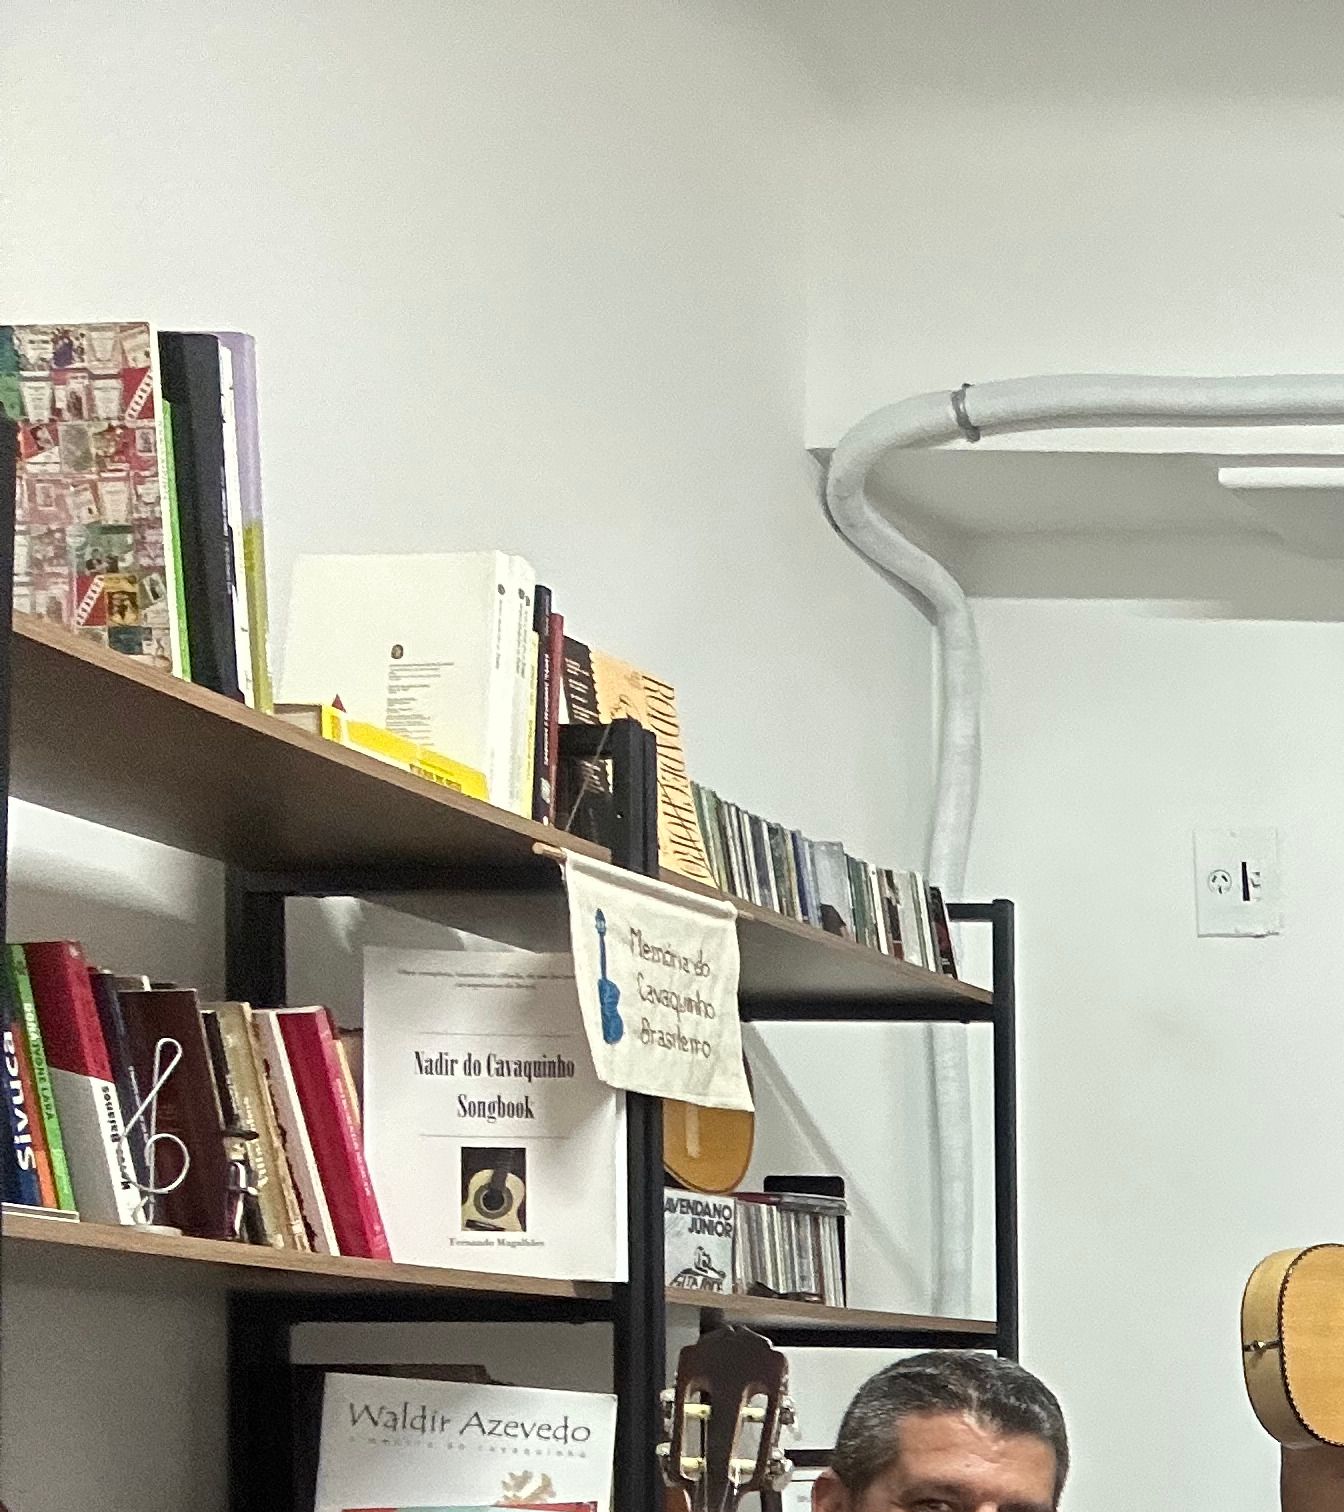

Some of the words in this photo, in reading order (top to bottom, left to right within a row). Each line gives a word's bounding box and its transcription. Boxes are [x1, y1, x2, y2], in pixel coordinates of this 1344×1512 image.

[414, 1050, 459, 1077] Nadir
[463, 1052, 482, 1078] do
[486, 1052, 576, 1083] Cavaquinho
[3, 1030, 37, 1172] Sivuca
[456, 1093, 535, 1124] Songbook
[349, 1401, 451, 1434] Waldir
[459, 1410, 591, 1445] Azevedo
